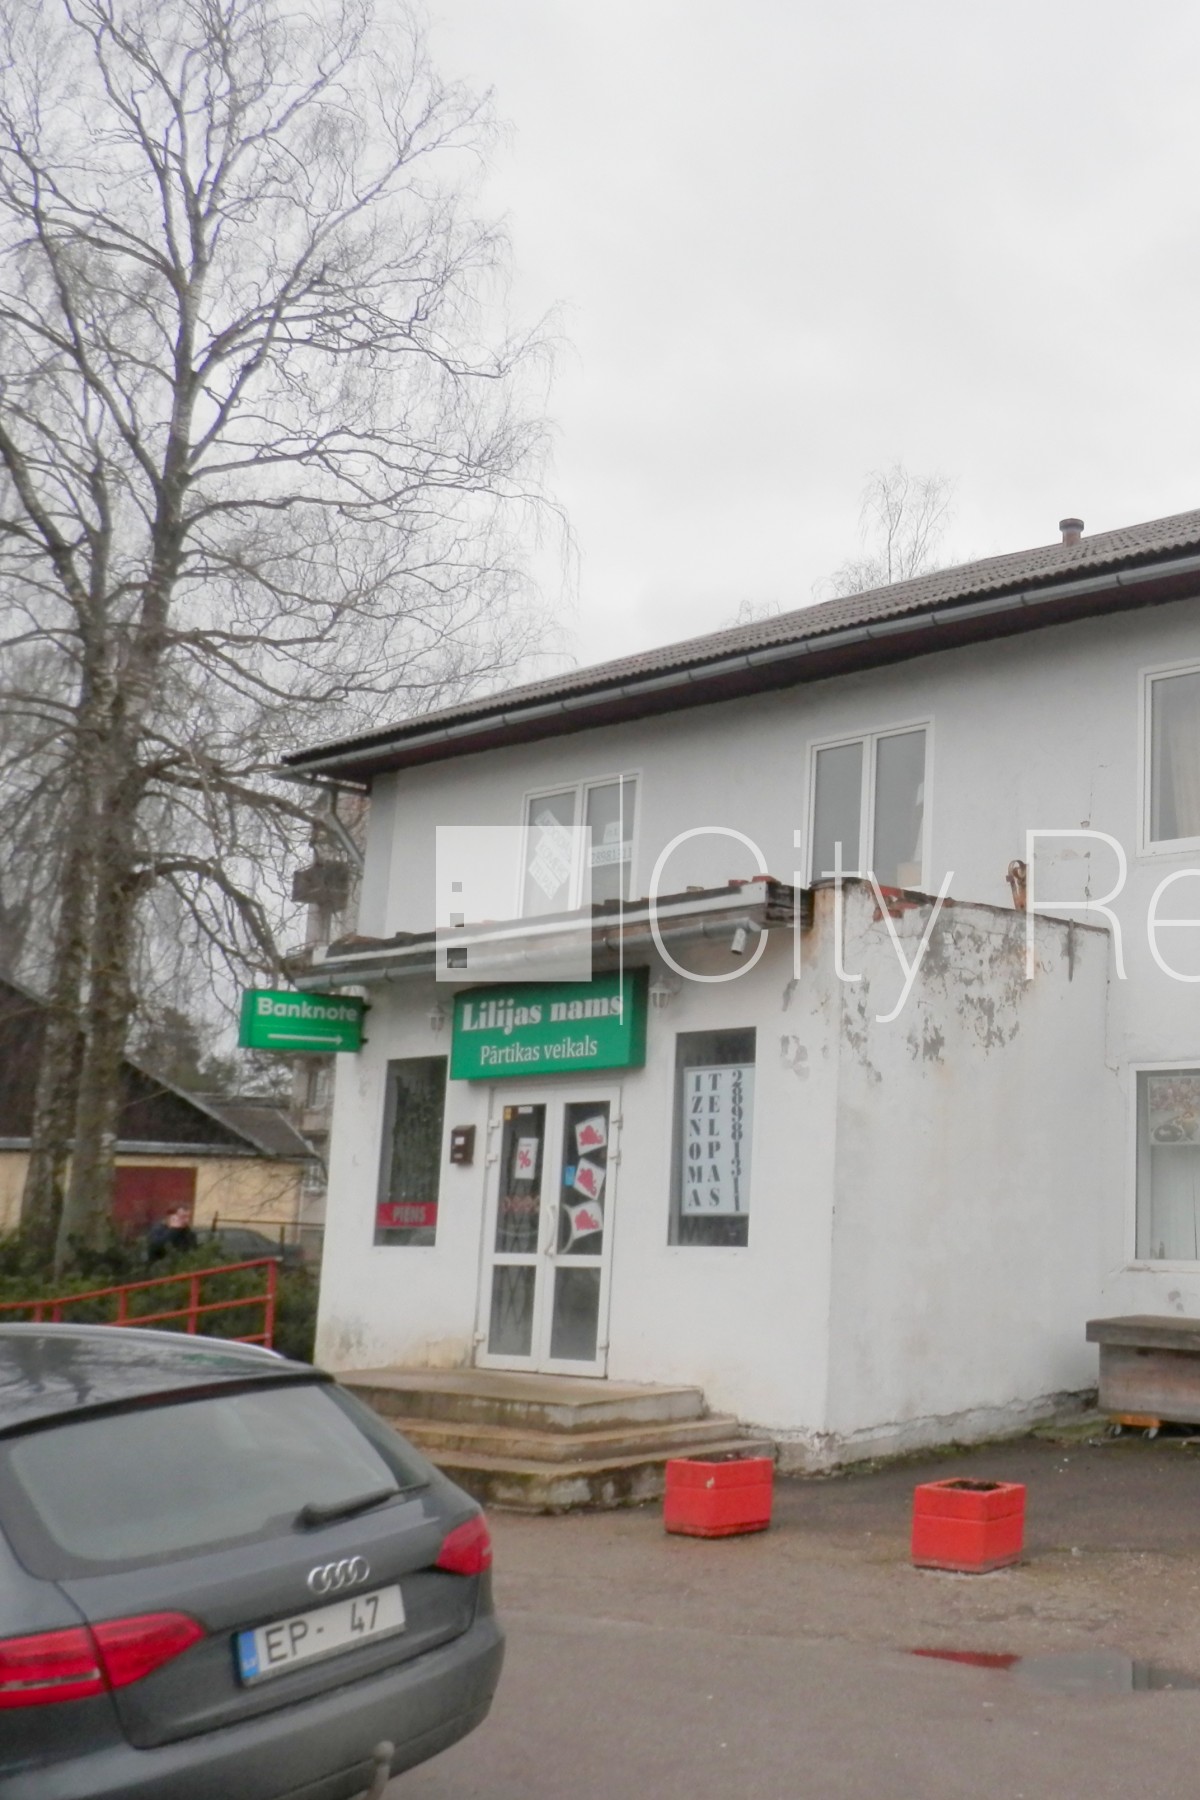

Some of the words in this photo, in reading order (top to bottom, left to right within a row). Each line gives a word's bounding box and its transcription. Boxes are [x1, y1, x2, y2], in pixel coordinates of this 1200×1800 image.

[257, 997, 358, 1021] Banknote
[461, 998, 542, 1035] Lilijas
[550, 995, 622, 1022] nams
[480, 1042, 540, 1066] Pārtikas
[544, 1035, 598, 1059] veikals
[707, 1073, 722, 1208] TELPAS
[392, 1206, 426, 1223] PIENS
